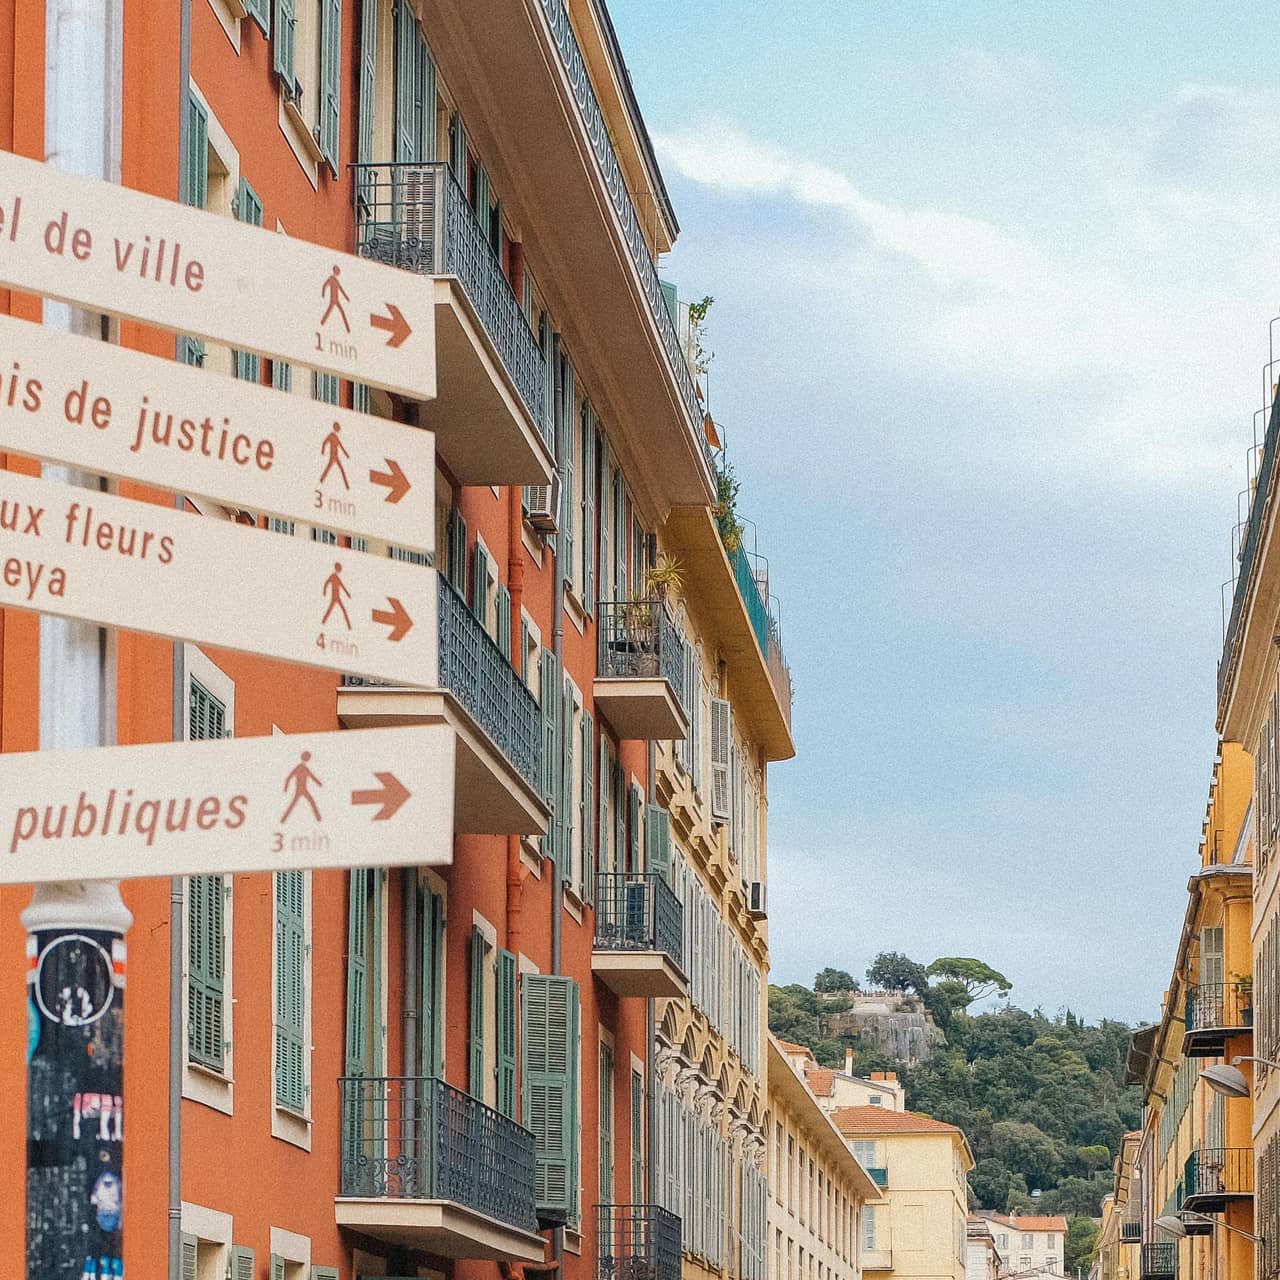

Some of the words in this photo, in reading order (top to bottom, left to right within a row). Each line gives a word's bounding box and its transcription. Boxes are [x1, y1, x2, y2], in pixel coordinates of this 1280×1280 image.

[44, 211, 93, 261] de
[114, 235, 205, 293] ville
[315, 331, 323, 352] 1
[330, 340, 358, 361] min
[64, 380, 113, 430] de
[130, 396, 275, 471] justice
[314, 489, 323, 509] 3
[64, 503, 175, 564] fleurs
[316, 632, 326, 650] 4
[10, 789, 249, 854] publiques
[272, 832, 284, 853] 3
